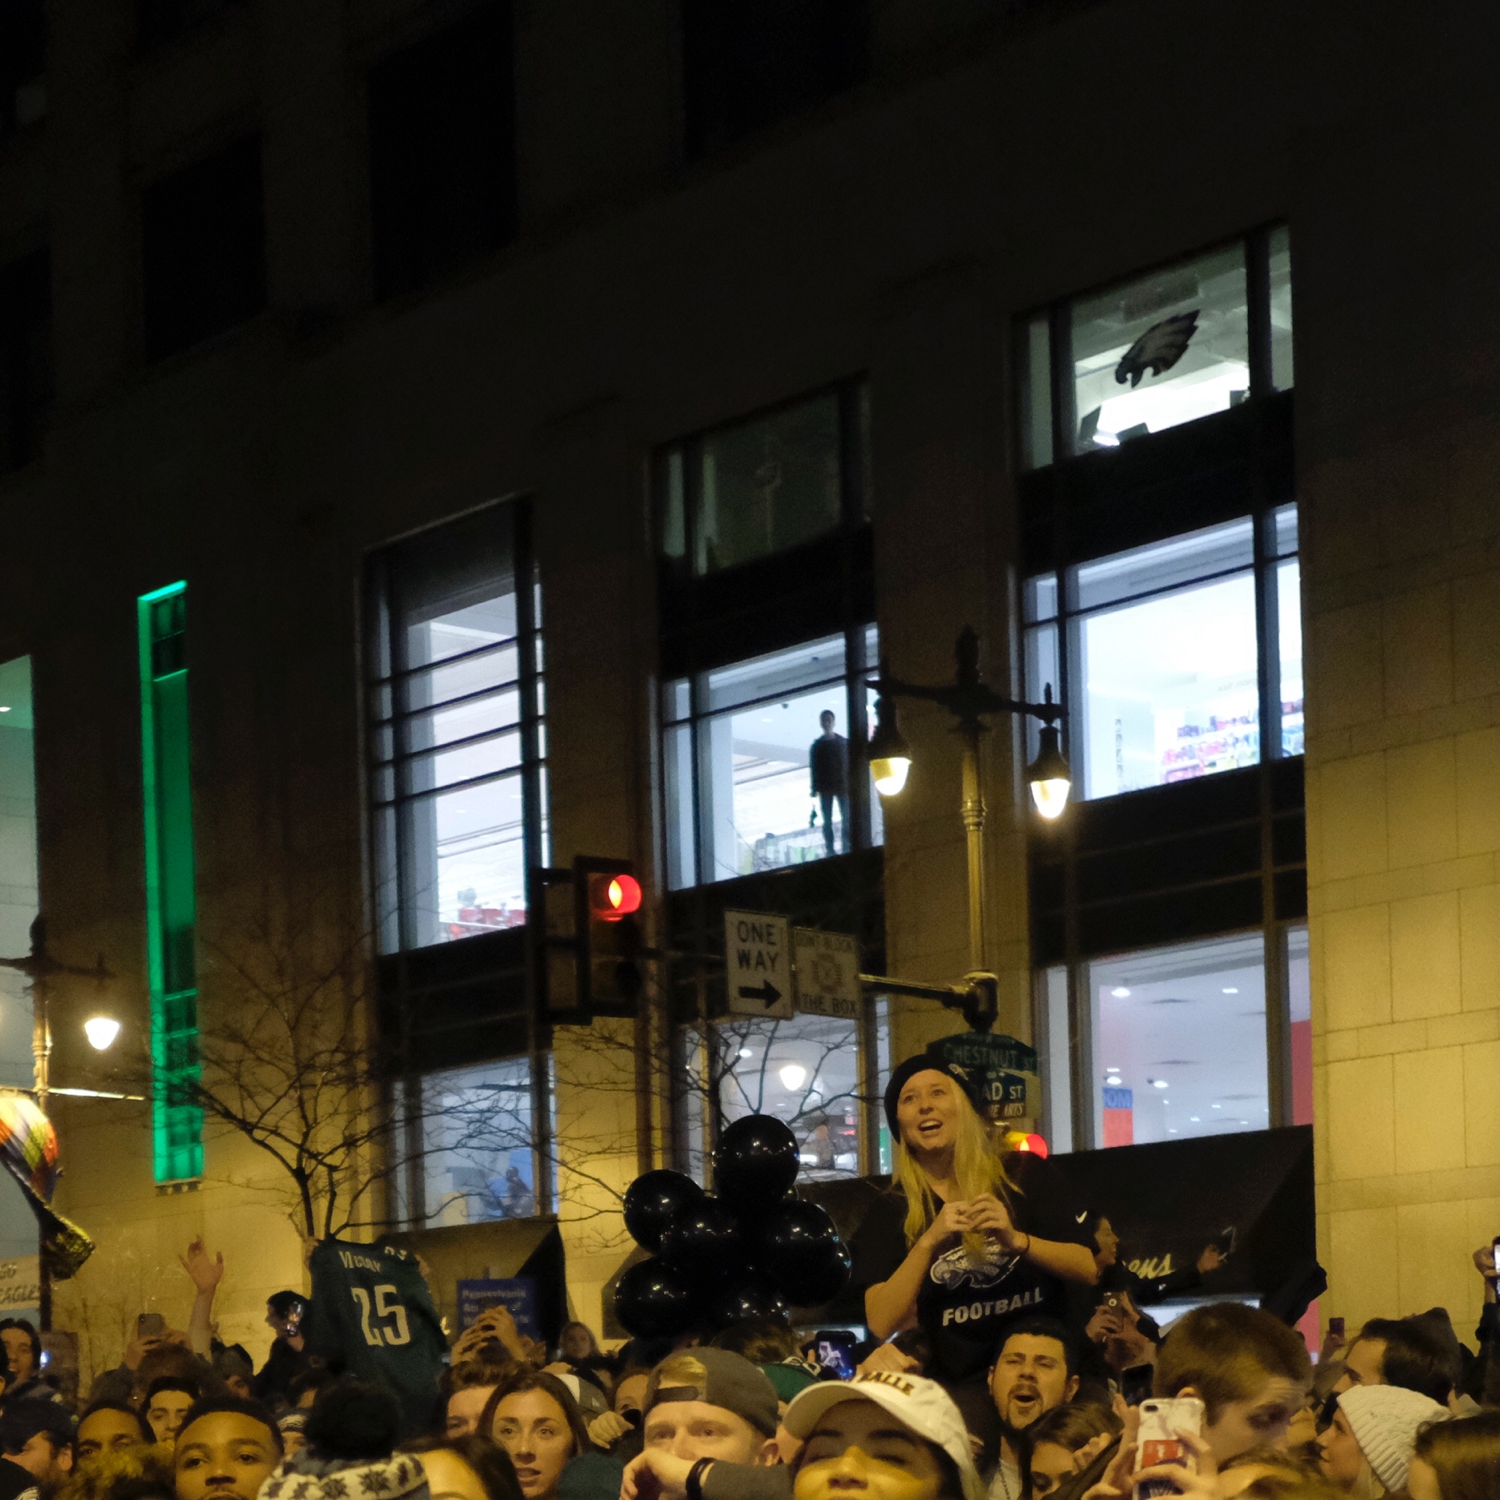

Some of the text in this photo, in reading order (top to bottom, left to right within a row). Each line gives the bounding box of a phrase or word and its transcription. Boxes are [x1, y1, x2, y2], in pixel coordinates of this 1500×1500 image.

[737, 920, 776, 945] ONE
[737, 949, 779, 972] WAY
[803, 993, 857, 1015] THE BOX
[943, 1042, 1018, 1070] CHESTNUT
[1009, 1085, 1023, 1100] ST
[1004, 1102, 1025, 1117] ARTS
[350, 1284, 411, 1347] 25
[942, 1286, 1043, 1327] FOOTBALL
